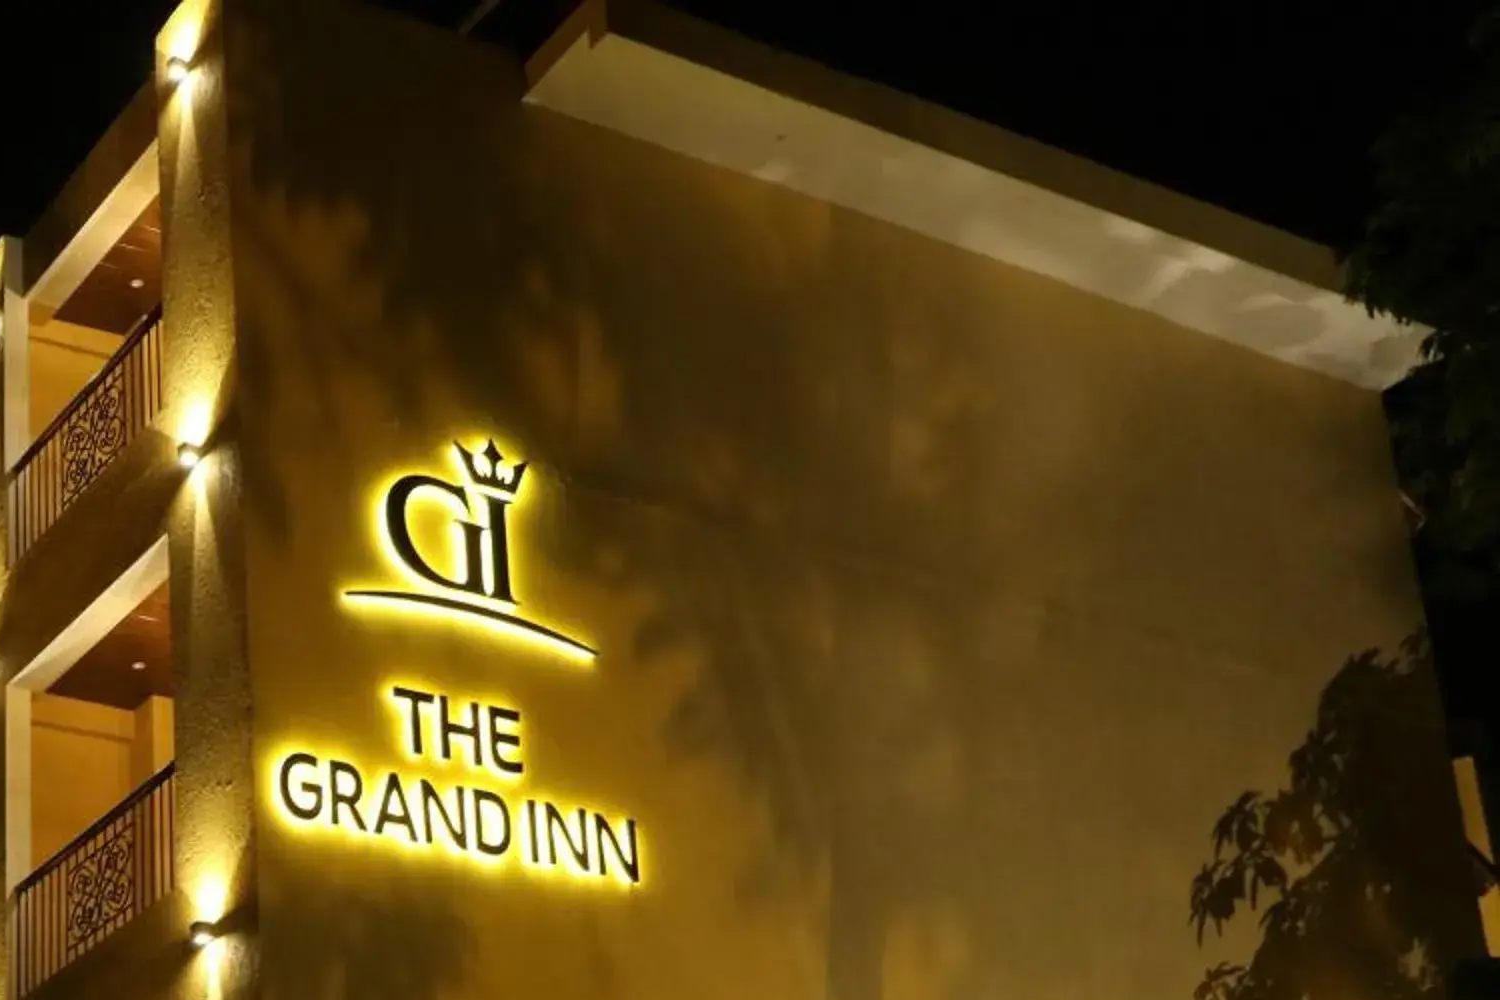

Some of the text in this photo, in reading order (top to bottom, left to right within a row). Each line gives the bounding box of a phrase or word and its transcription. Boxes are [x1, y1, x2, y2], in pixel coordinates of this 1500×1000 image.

[392, 686, 523, 774] THE
[279, 752, 641, 883] GRAND INN
